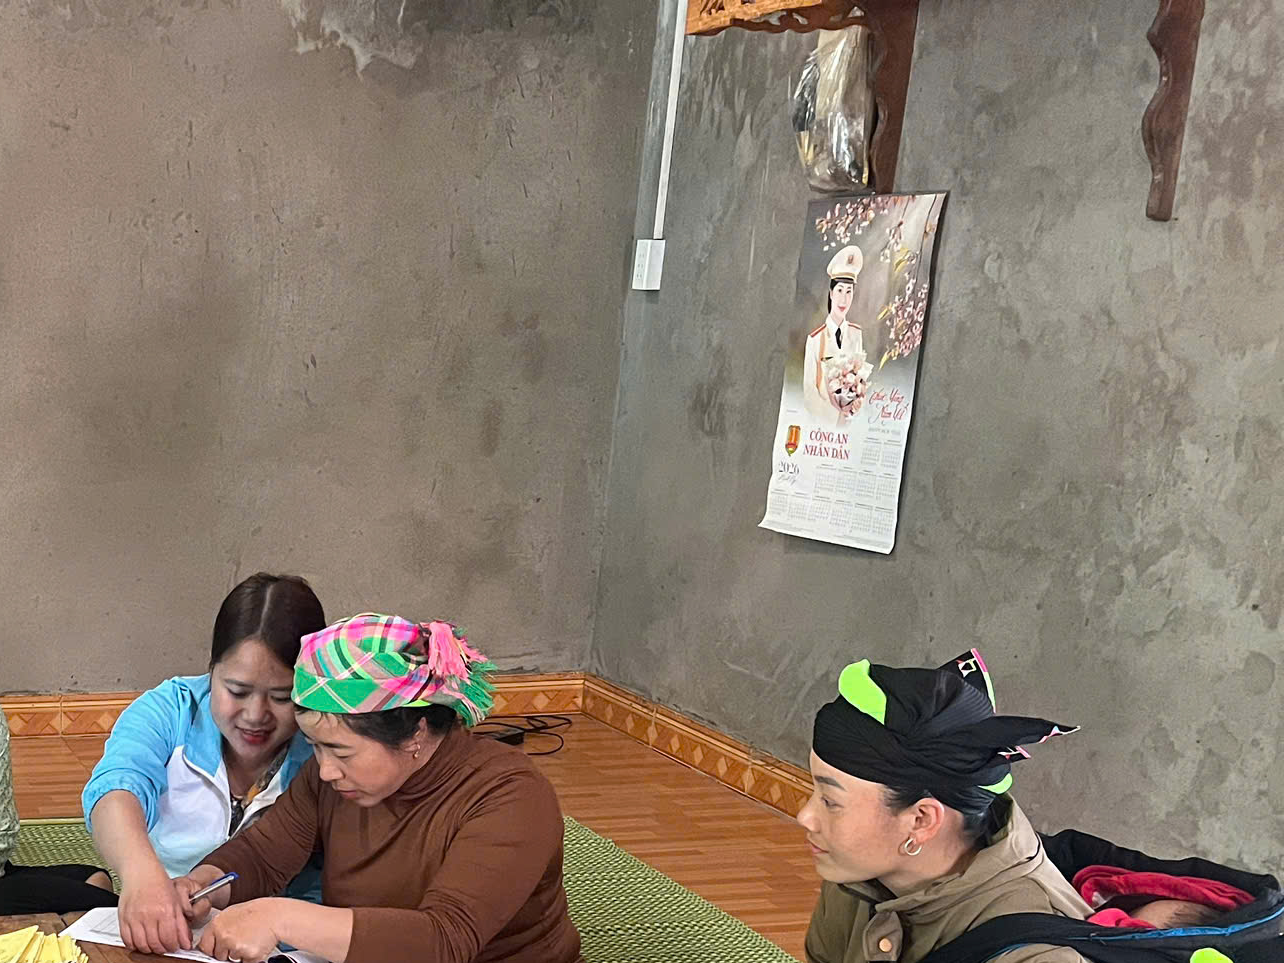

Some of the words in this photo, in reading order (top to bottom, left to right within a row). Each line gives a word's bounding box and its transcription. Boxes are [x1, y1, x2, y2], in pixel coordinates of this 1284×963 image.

[809, 427, 835, 443] CÔNG
[836, 433, 849, 444] AN
[803, 443, 830, 457] NHÂN
[831, 446, 850, 460] DÂN
